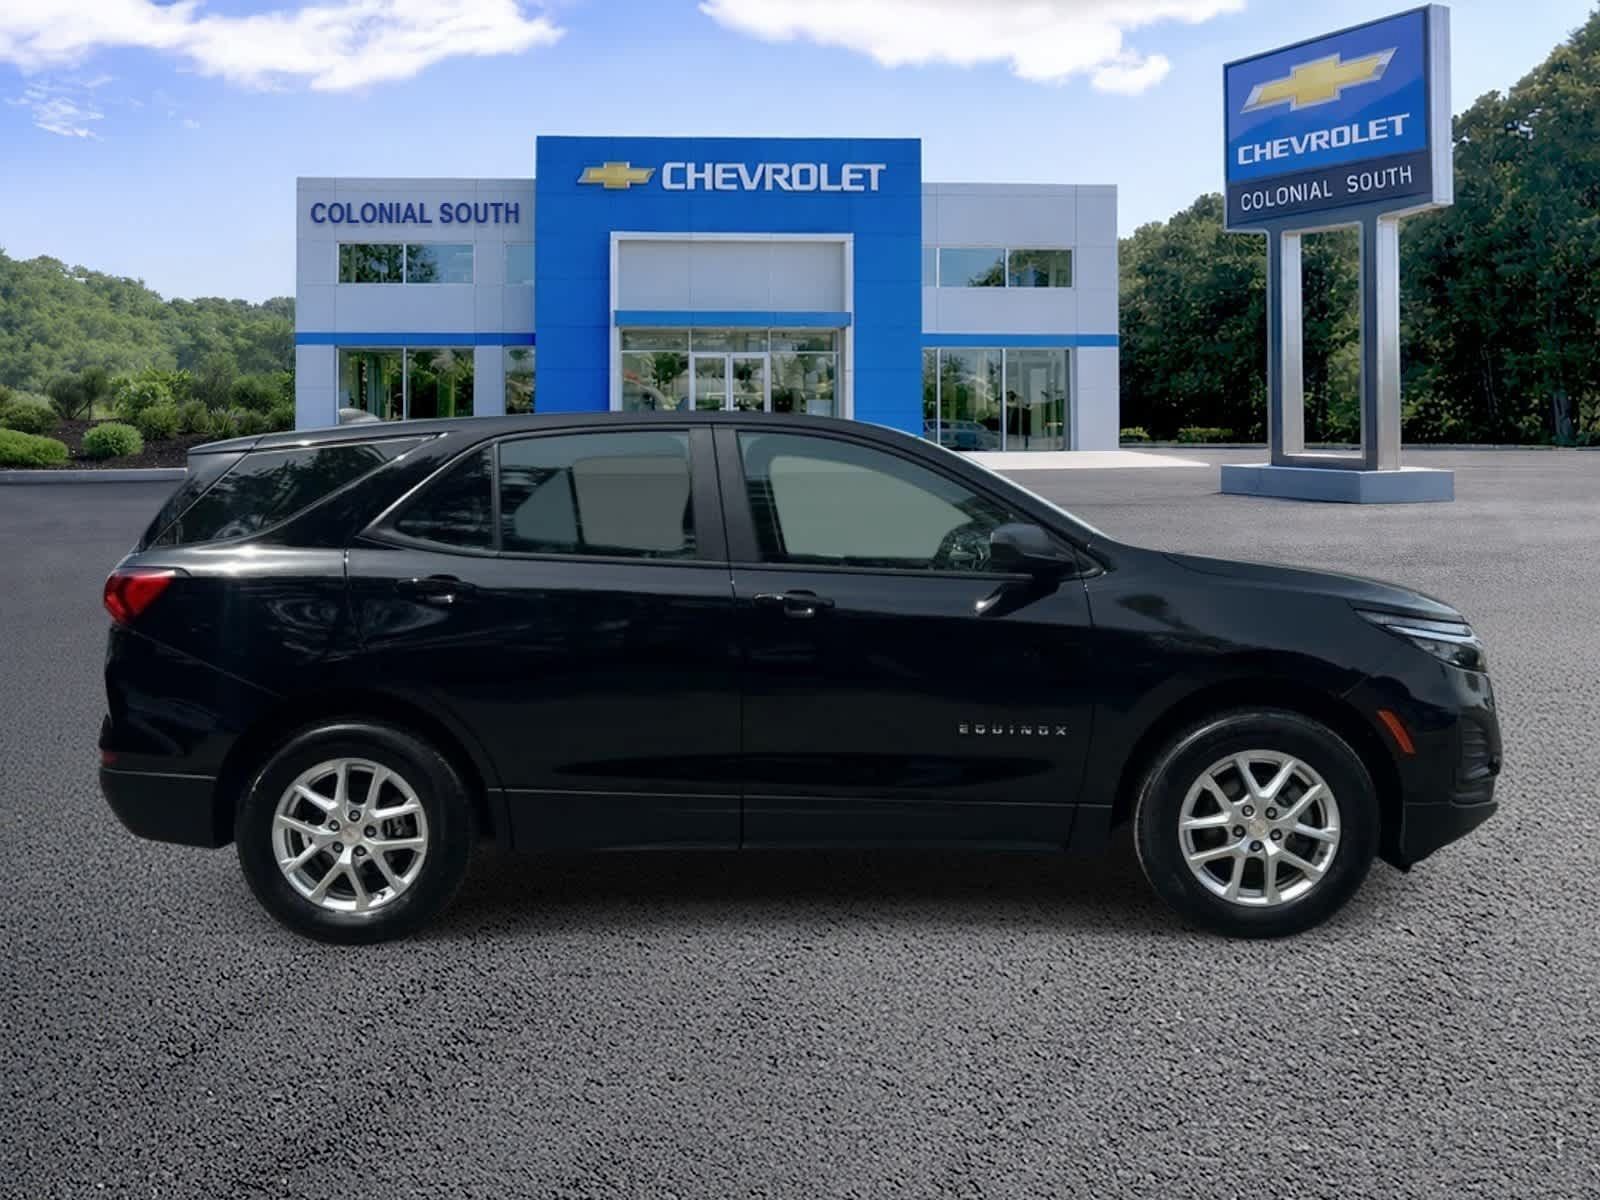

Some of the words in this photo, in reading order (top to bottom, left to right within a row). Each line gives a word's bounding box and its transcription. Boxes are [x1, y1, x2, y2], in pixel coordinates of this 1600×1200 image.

[1237, 113, 1410, 165] CHEVROLET
[661, 162, 887, 192] CHEVROLET
[1241, 180, 1333, 211] COLONIAL
[1346, 165, 1412, 193] SOUTH
[310, 202, 433, 225] COLONIAL
[438, 202, 520, 225] SOUTH
[958, 724, 1067, 736] EQUINOX
